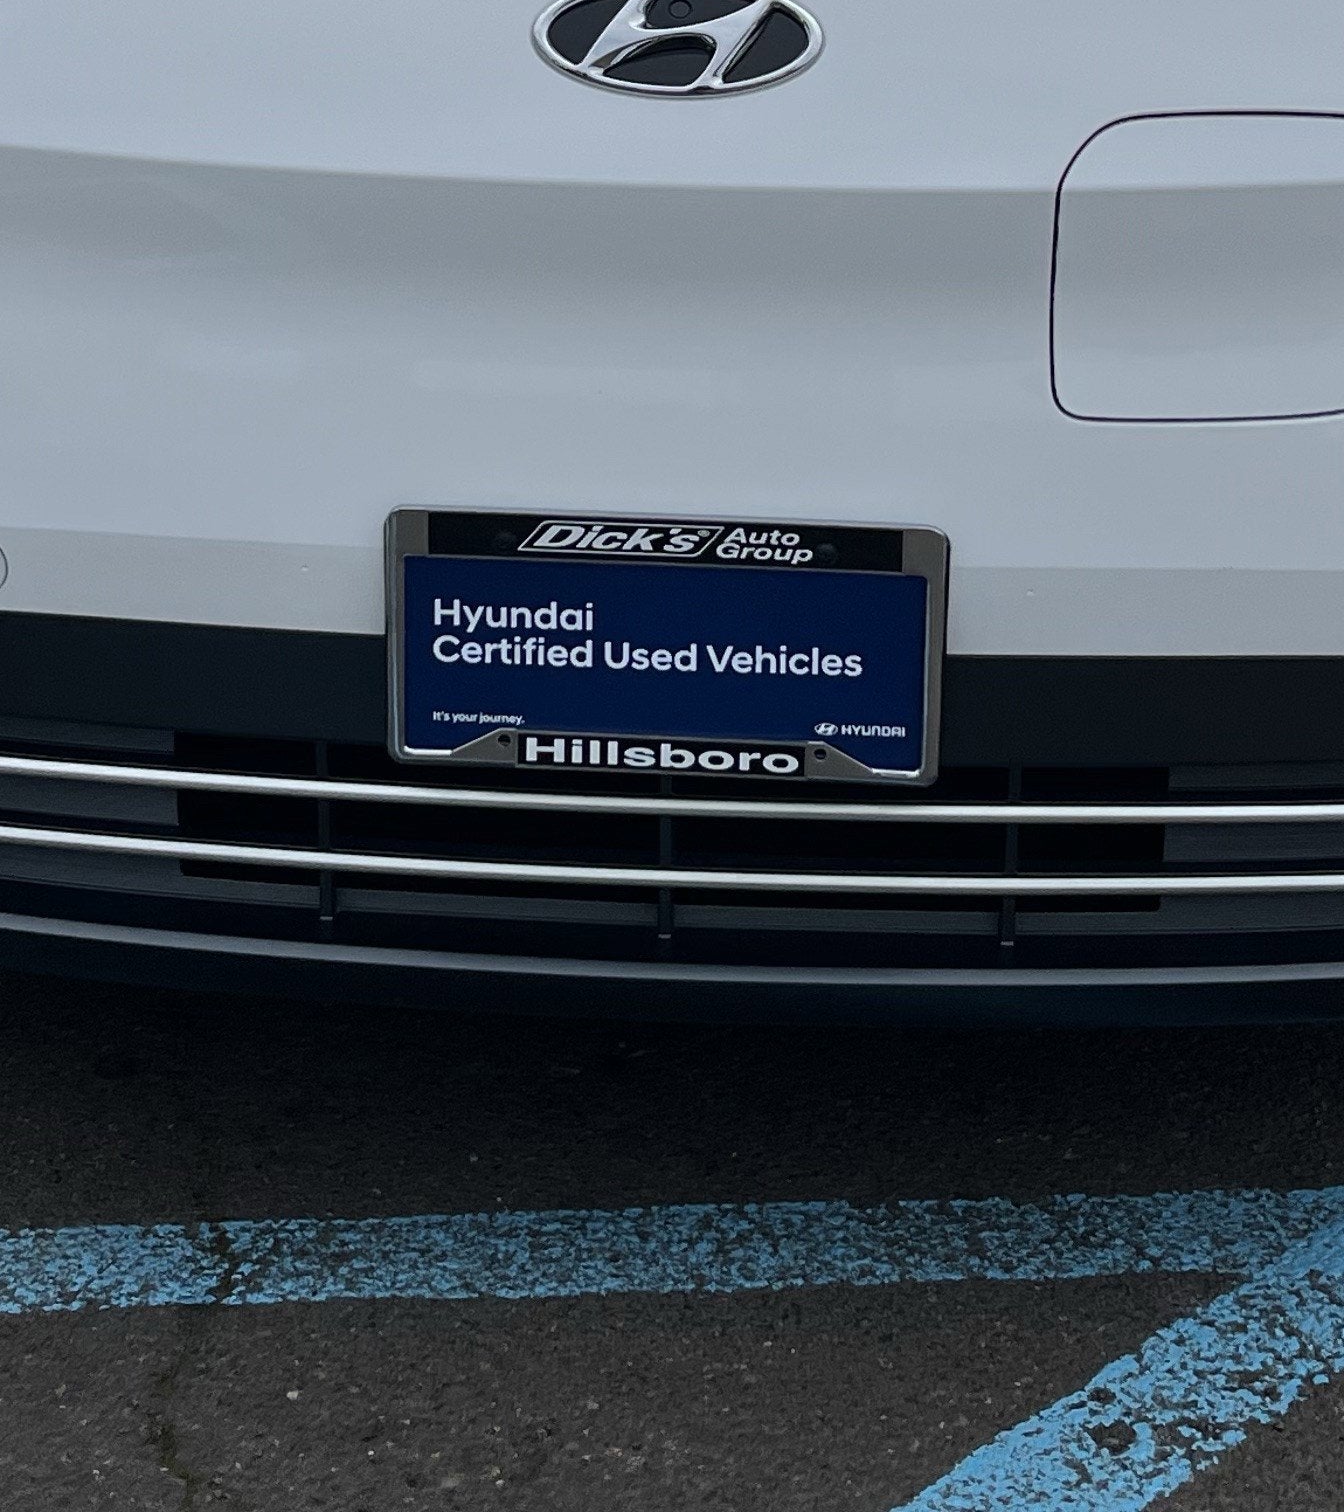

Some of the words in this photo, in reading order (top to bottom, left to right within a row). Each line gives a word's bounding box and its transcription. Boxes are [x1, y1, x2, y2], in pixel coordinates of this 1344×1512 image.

[533, 524, 701, 553] Dick's
[723, 527, 800, 546] Auto
[716, 543, 813, 565] Group
[433, 598, 594, 634] Hyundai
[432, 634, 594, 668] Certified
[604, 641, 698, 671] Used
[706, 644, 864, 677] Vehicles
[432, 710, 451, 722] It's
[451, 712, 478, 725] your
[478, 711, 526, 726] journey.
[841, 724, 906, 738] HYUNDAI
[525, 737, 800, 774] Hillsboro
